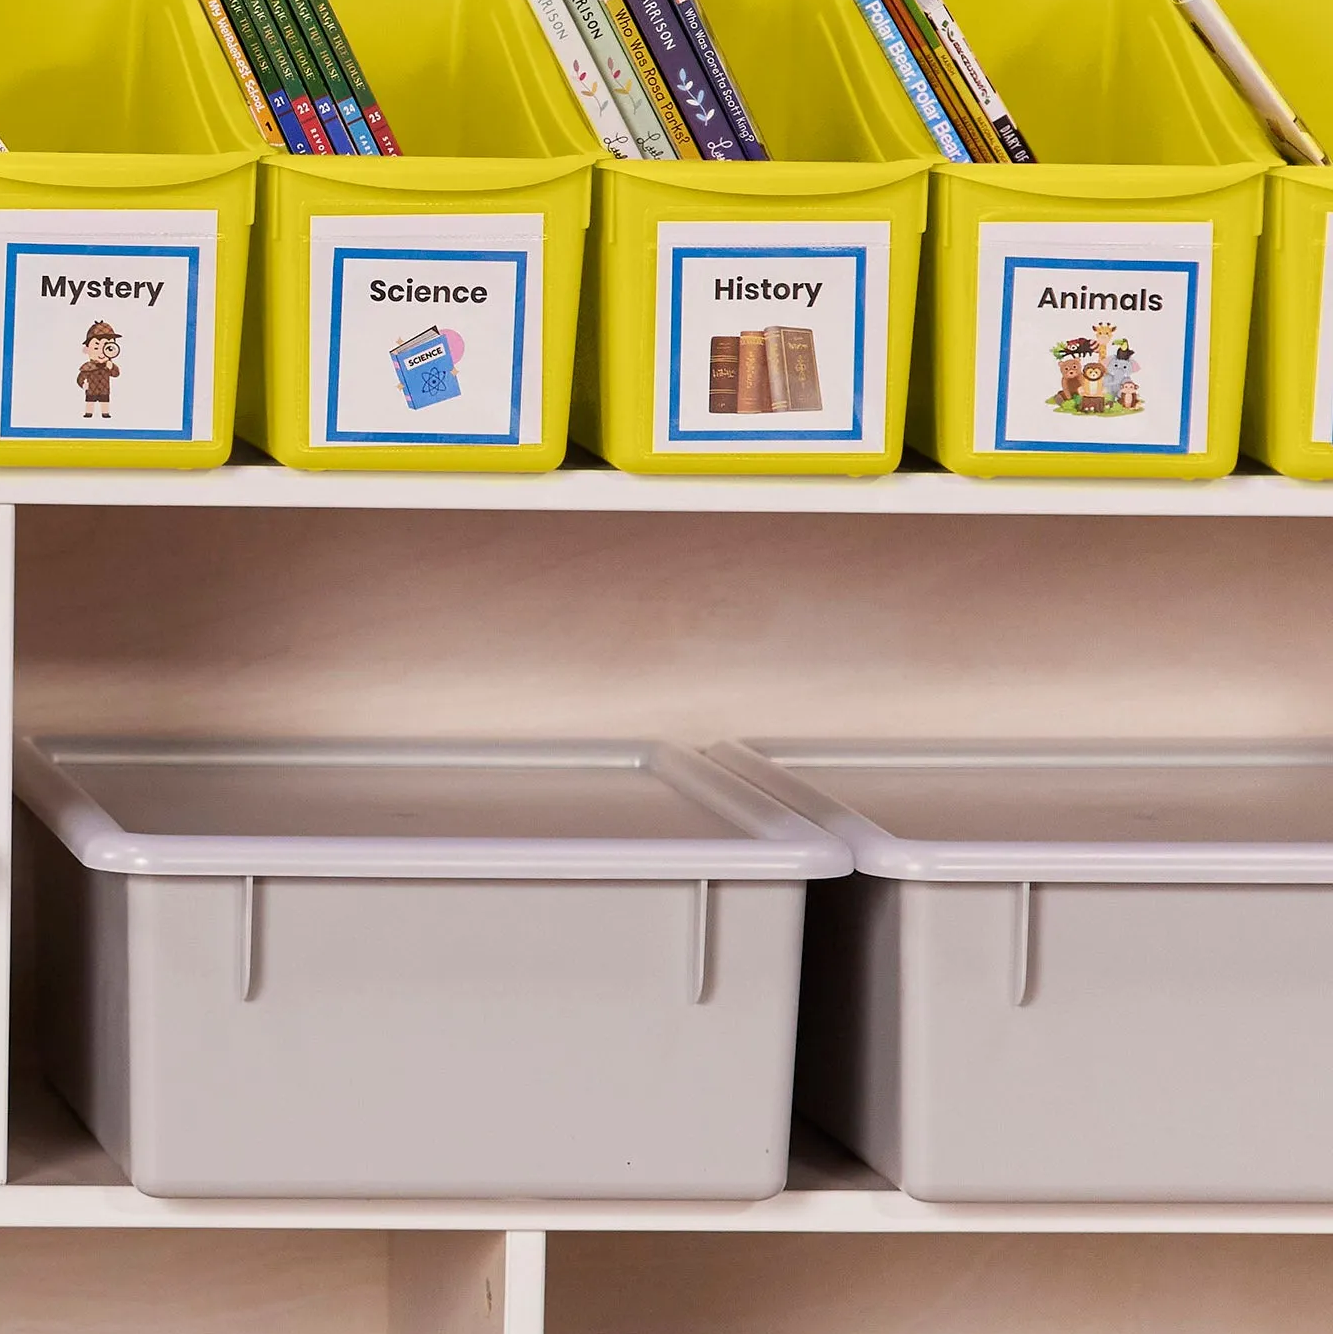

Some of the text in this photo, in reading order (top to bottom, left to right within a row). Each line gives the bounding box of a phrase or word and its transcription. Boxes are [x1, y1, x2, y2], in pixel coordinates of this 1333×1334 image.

[208, 0, 221, 16] My
[239, 18, 254, 40] TREE
[262, 24, 278, 50] TREE
[283, 24, 298, 48] TREE
[308, 25, 323, 47] TREE
[317, 3, 337, 33] MAGIC
[333, 34, 349, 60] TREE
[864, 0, 895, 41] Polar
[888, 39, 916, 82] Bear,
[910, 80, 941, 121] Polar
[941, 55, 956, 75] MARSH
[615, 8, 691, 144] Who Was Rosa Parks?
[684, 7, 755, 143] Who Was Coretta Scott King?
[274, 96, 285, 107] 21
[297, 101, 310, 114] 22
[319, 101, 331, 113] 23
[343, 104, 356, 115] 24
[265, 121, 273, 132] 1
[369, 111, 382, 123] 25
[977, 117, 996, 144] NATIONAL
[1000, 125, 1029, 162] DIARY OF
[41, 274, 165, 307] Mystery
[369, 278, 488, 304] Science
[714, 276, 823, 308] History
[1037, 285, 1163, 312] Animals
[408, 347, 443, 366] SCIENCE
